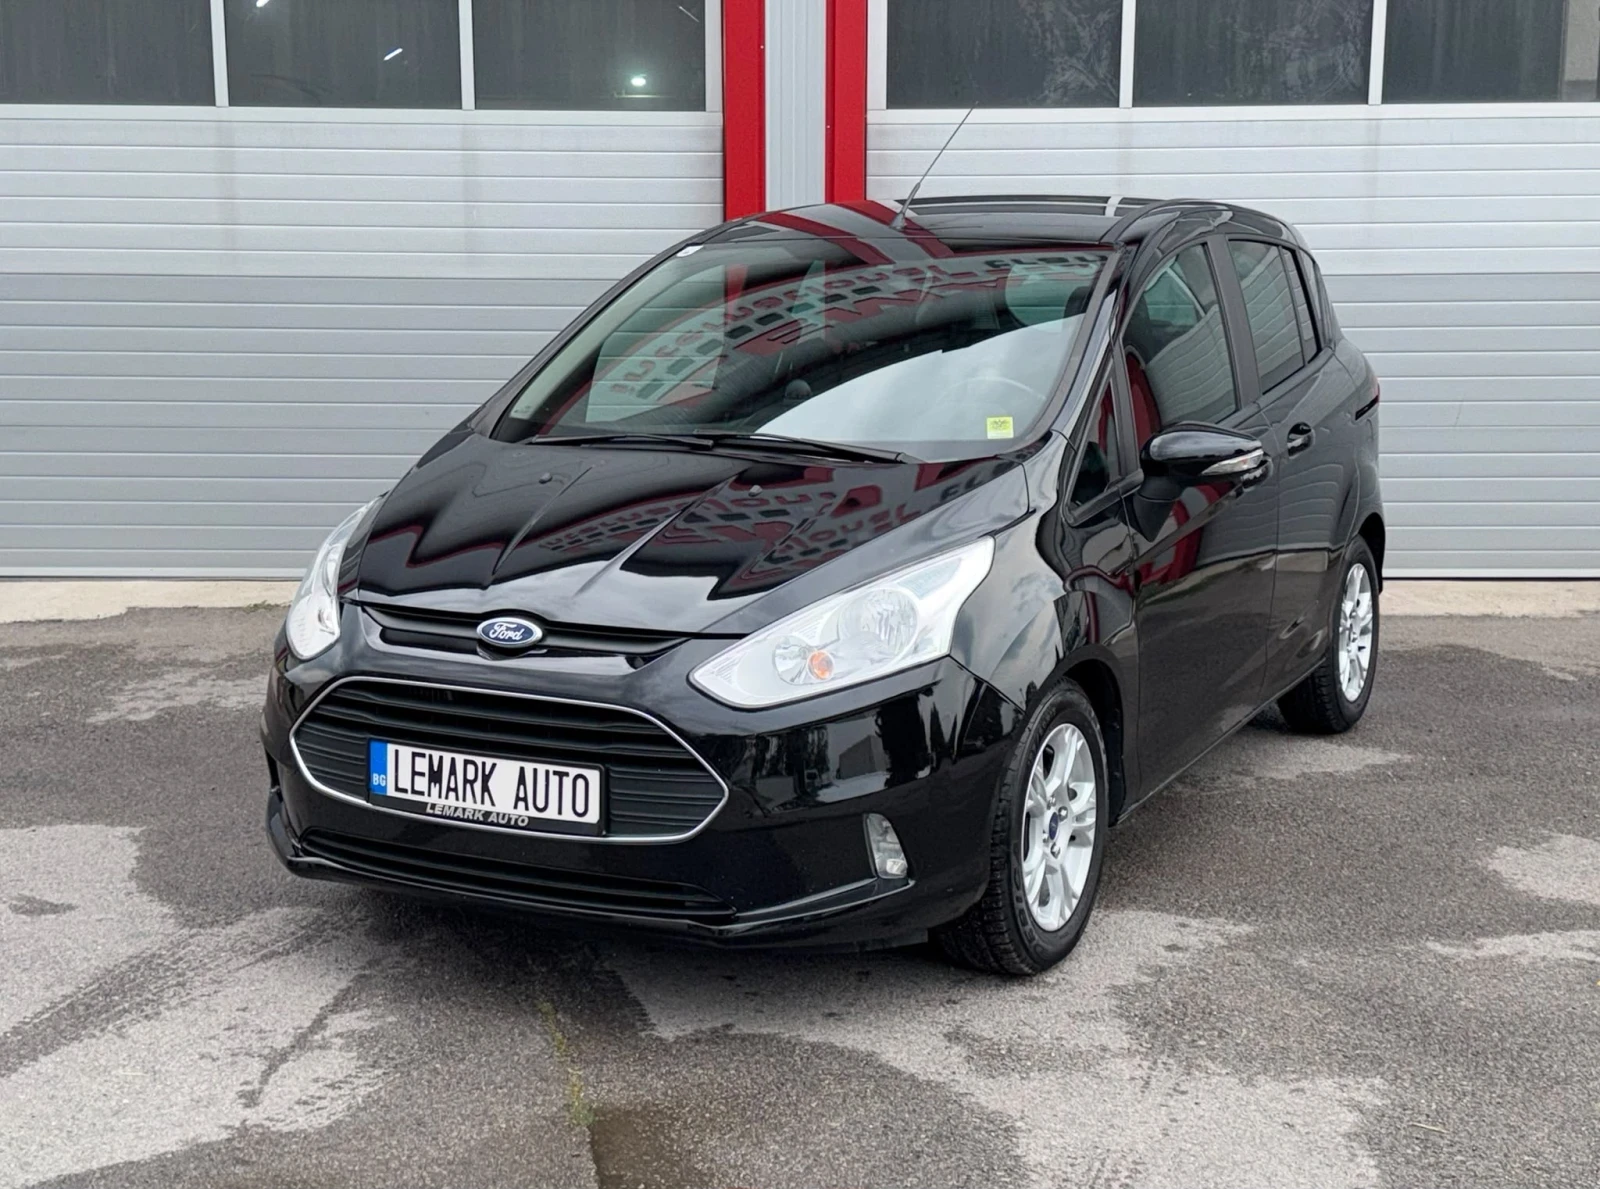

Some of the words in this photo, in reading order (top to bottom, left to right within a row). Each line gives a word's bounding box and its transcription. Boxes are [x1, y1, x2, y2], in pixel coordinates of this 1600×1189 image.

[488, 622, 525, 641] Ford
[372, 773, 387, 788] BG
[393, 748, 498, 808] LEMARK
[513, 765, 590, 818] AUTO
[425, 801, 485, 822] LEMARK
[487, 811, 530, 828] AUTO
